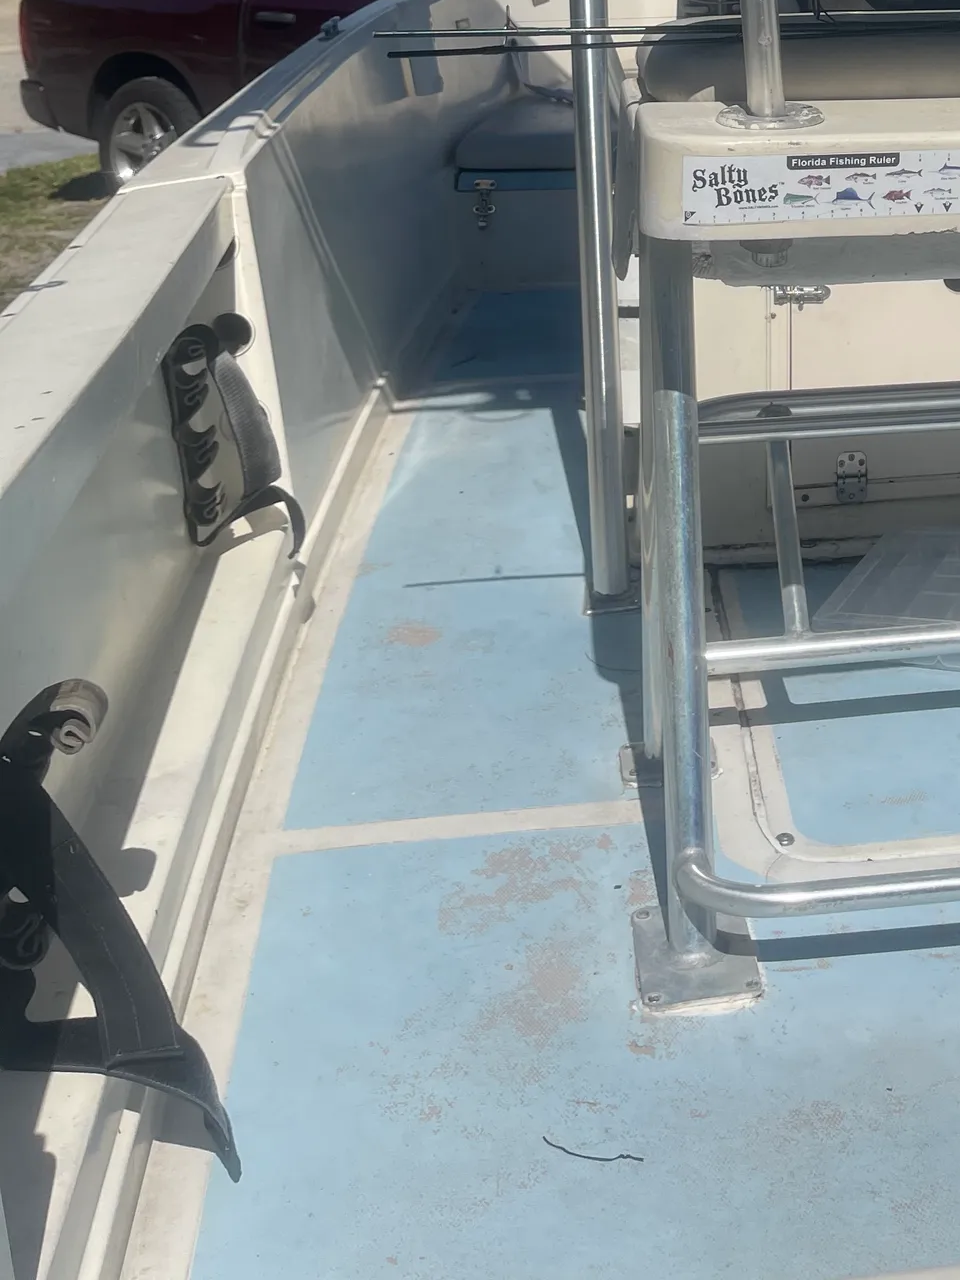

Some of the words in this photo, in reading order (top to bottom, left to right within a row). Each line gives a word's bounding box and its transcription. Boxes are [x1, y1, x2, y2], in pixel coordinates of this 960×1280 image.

[791, 158, 827, 168] Florida
[829, 156, 867, 167] Fishing
[869, 156, 896, 165] Ruler
[691, 164, 749, 192] Salty
[714, 182, 780, 208] Bones
